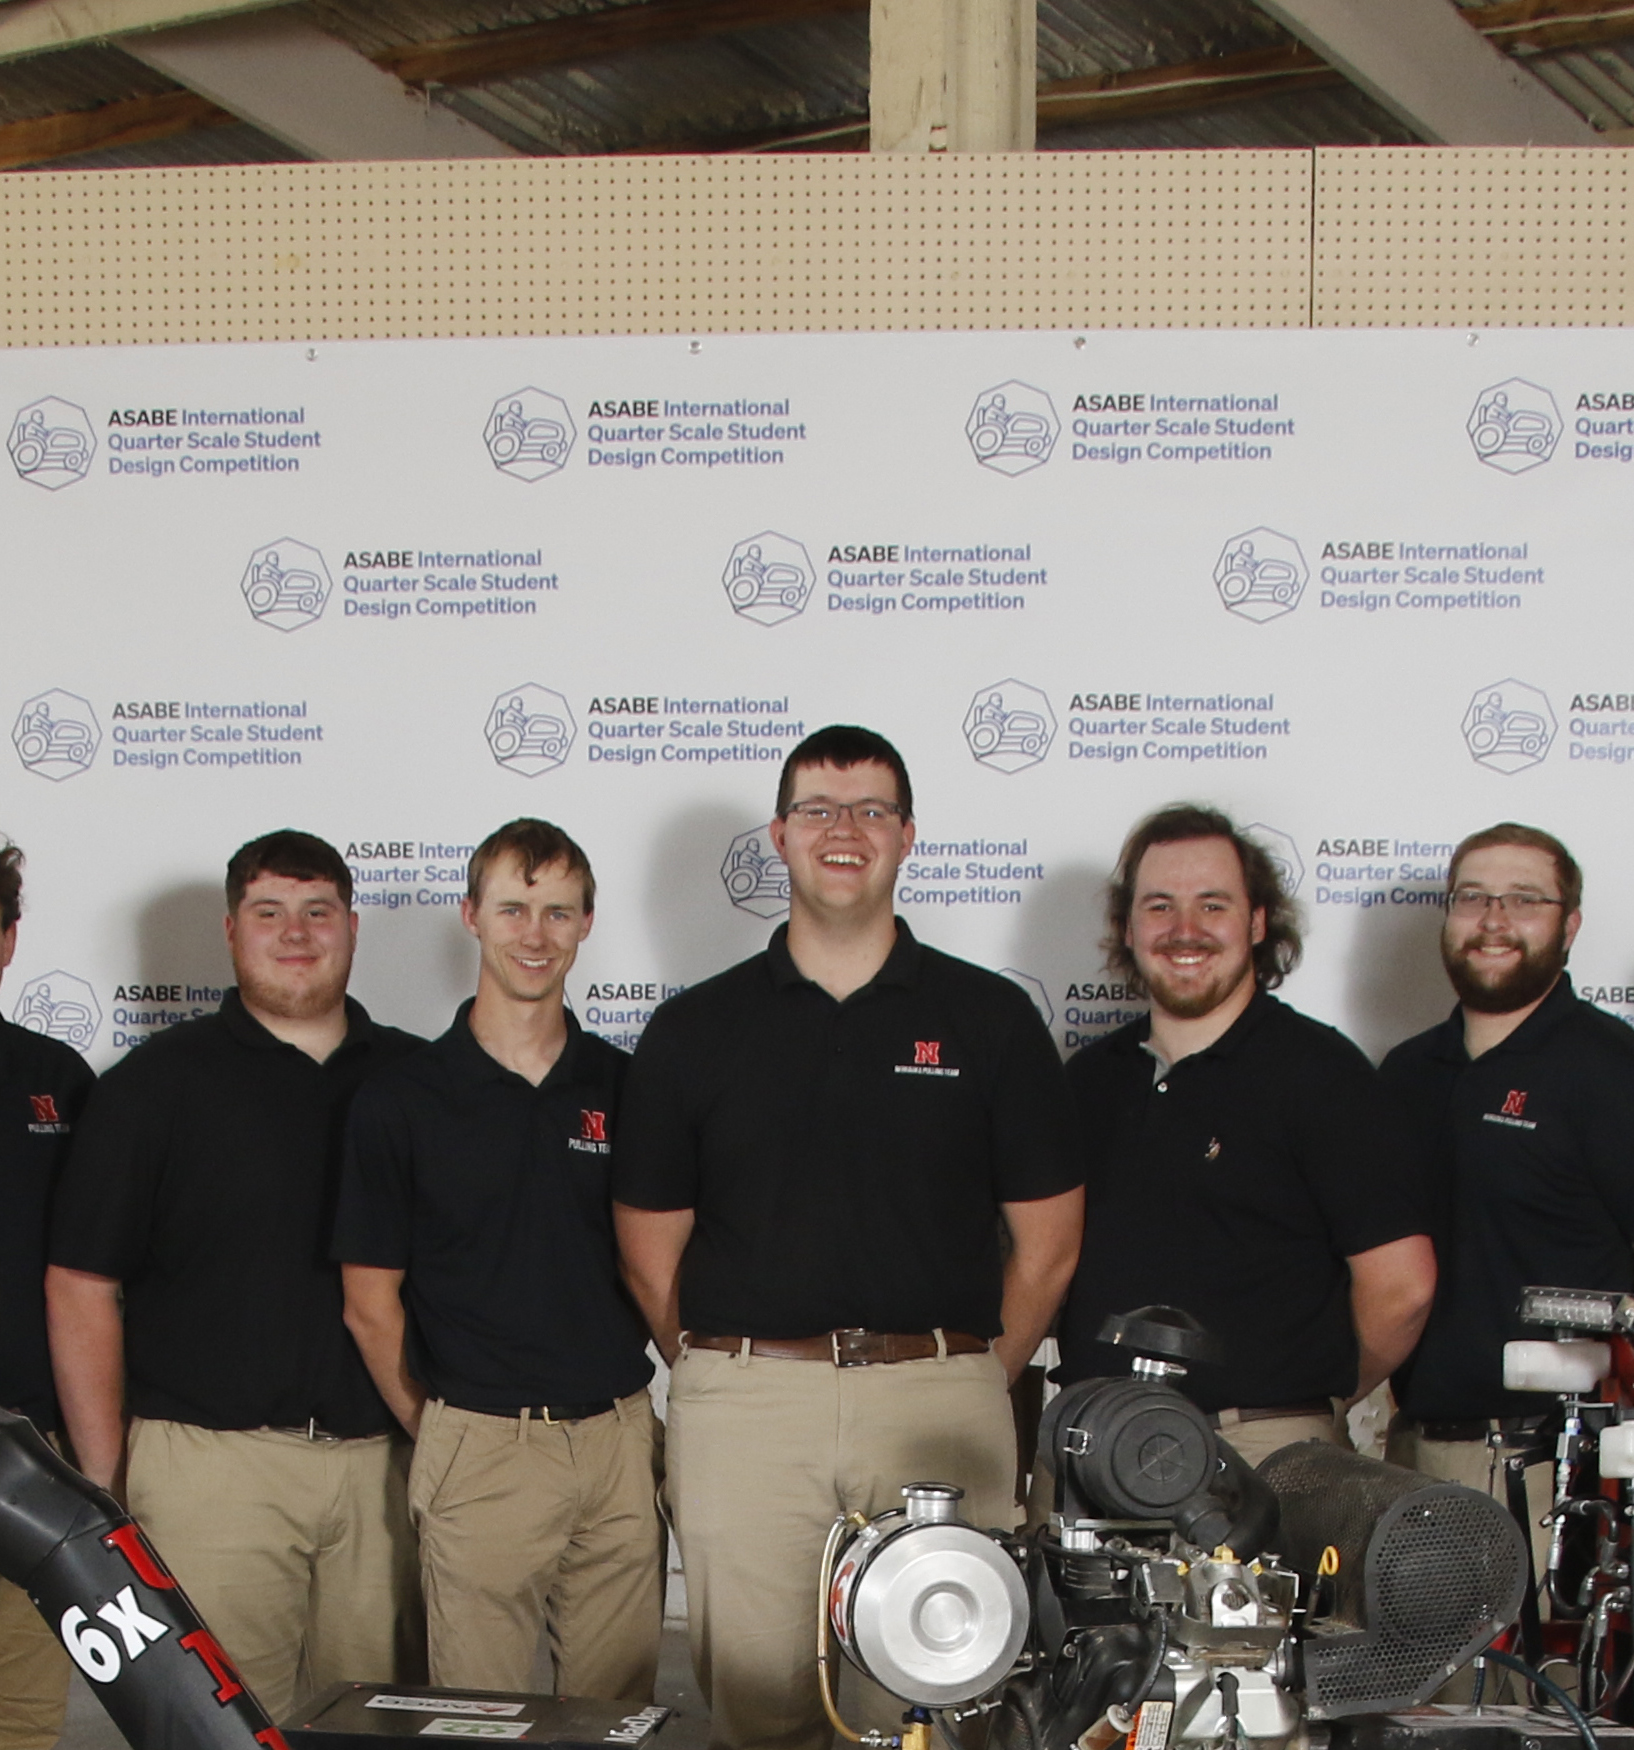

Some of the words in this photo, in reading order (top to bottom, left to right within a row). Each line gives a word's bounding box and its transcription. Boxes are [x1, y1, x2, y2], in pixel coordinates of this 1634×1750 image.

[588, 400, 659, 419] ASABE
[664, 398, 789, 417] International
[1072, 394, 1145, 412] ASABE
[1150, 394, 1278, 412] International
[108, 409, 178, 427] ASABE
[182, 407, 304, 426] International
[588, 424, 665, 444] Quarter
[669, 423, 723, 441] Scale
[728, 422, 806, 440] Student
[1072, 419, 1151, 438] Quarter
[1155, 418, 1210, 436] Scale
[1215, 418, 1294, 435] Student
[108, 433, 183, 452] Quarter
[187, 432, 240, 449] Scale
[245, 431, 321, 448] Student
[588, 448, 656, 469] Design
[661, 447, 783, 468] Competition
[1073, 442, 1141, 464] Design
[1147, 442, 1271, 463] Competition
[109, 456, 175, 477] Design
[180, 454, 299, 476] Competition
[343, 551, 413, 569] ASABE
[418, 549, 541, 568] International
[827, 545, 899, 563] ASABE
[905, 544, 1030, 562] International
[1321, 542, 1394, 560] ASABE
[1400, 543, 1527, 560] International
[344, 575, 419, 594] Quarter
[424, 574, 477, 591] Scale
[482, 573, 558, 590] Student
[827, 570, 905, 589] Quarter
[910, 569, 964, 586] Scale
[969, 568, 1047, 585] Student
[1321, 567, 1399, 586] Quarter
[1405, 567, 1459, 584] Scale
[1464, 567, 1544, 583] Student
[344, 599, 411, 619] Design
[416, 597, 536, 618] Competition
[828, 593, 896, 614] Design
[901, 592, 1024, 613] Competition
[1321, 591, 1390, 611] Design
[1396, 591, 1520, 611] Competition
[112, 702, 180, 720] ASABE
[185, 701, 306, 718] International
[588, 697, 659, 715] ASABE
[664, 696, 788, 714] International
[1069, 694, 1141, 711] ASABE
[1147, 694, 1273, 711] International
[113, 726, 186, 745] Quarter
[191, 725, 243, 742] Scale
[247, 724, 323, 741] Student
[588, 721, 665, 740] Quarter
[669, 720, 723, 738] Scale
[727, 720, 806, 739] Student
[1069, 718, 1147, 737] Quarter
[1151, 718, 1206, 735] Scale
[1211, 718, 1290, 735] Student
[114, 749, 178, 769] Design
[183, 748, 301, 768] Competition
[589, 745, 656, 765] Design
[661, 744, 783, 766] Competition
[1069, 742, 1138, 762] Design
[1143, 742, 1266, 762] Competition
[345, 841, 414, 859] ASABE
[908, 838, 1028, 856] nternational
[1316, 839, 1390, 857] ASABE
[425, 865, 468, 882] Scal
[906, 862, 961, 880] Scale
[965, 862, 1044, 880] Student
[1316, 863, 1394, 882] Quarter
[898, 886, 1022, 907] Competition
[1316, 887, 1386, 908] Design
[113, 985, 182, 1002] ASABE
[586, 983, 657, 1001] ASABE
[113, 1008, 187, 1027] Quarter
[586, 1007, 653, 1026] Quarte
[914, 1041, 940, 1066] N
[581, 1109, 606, 1141] N
